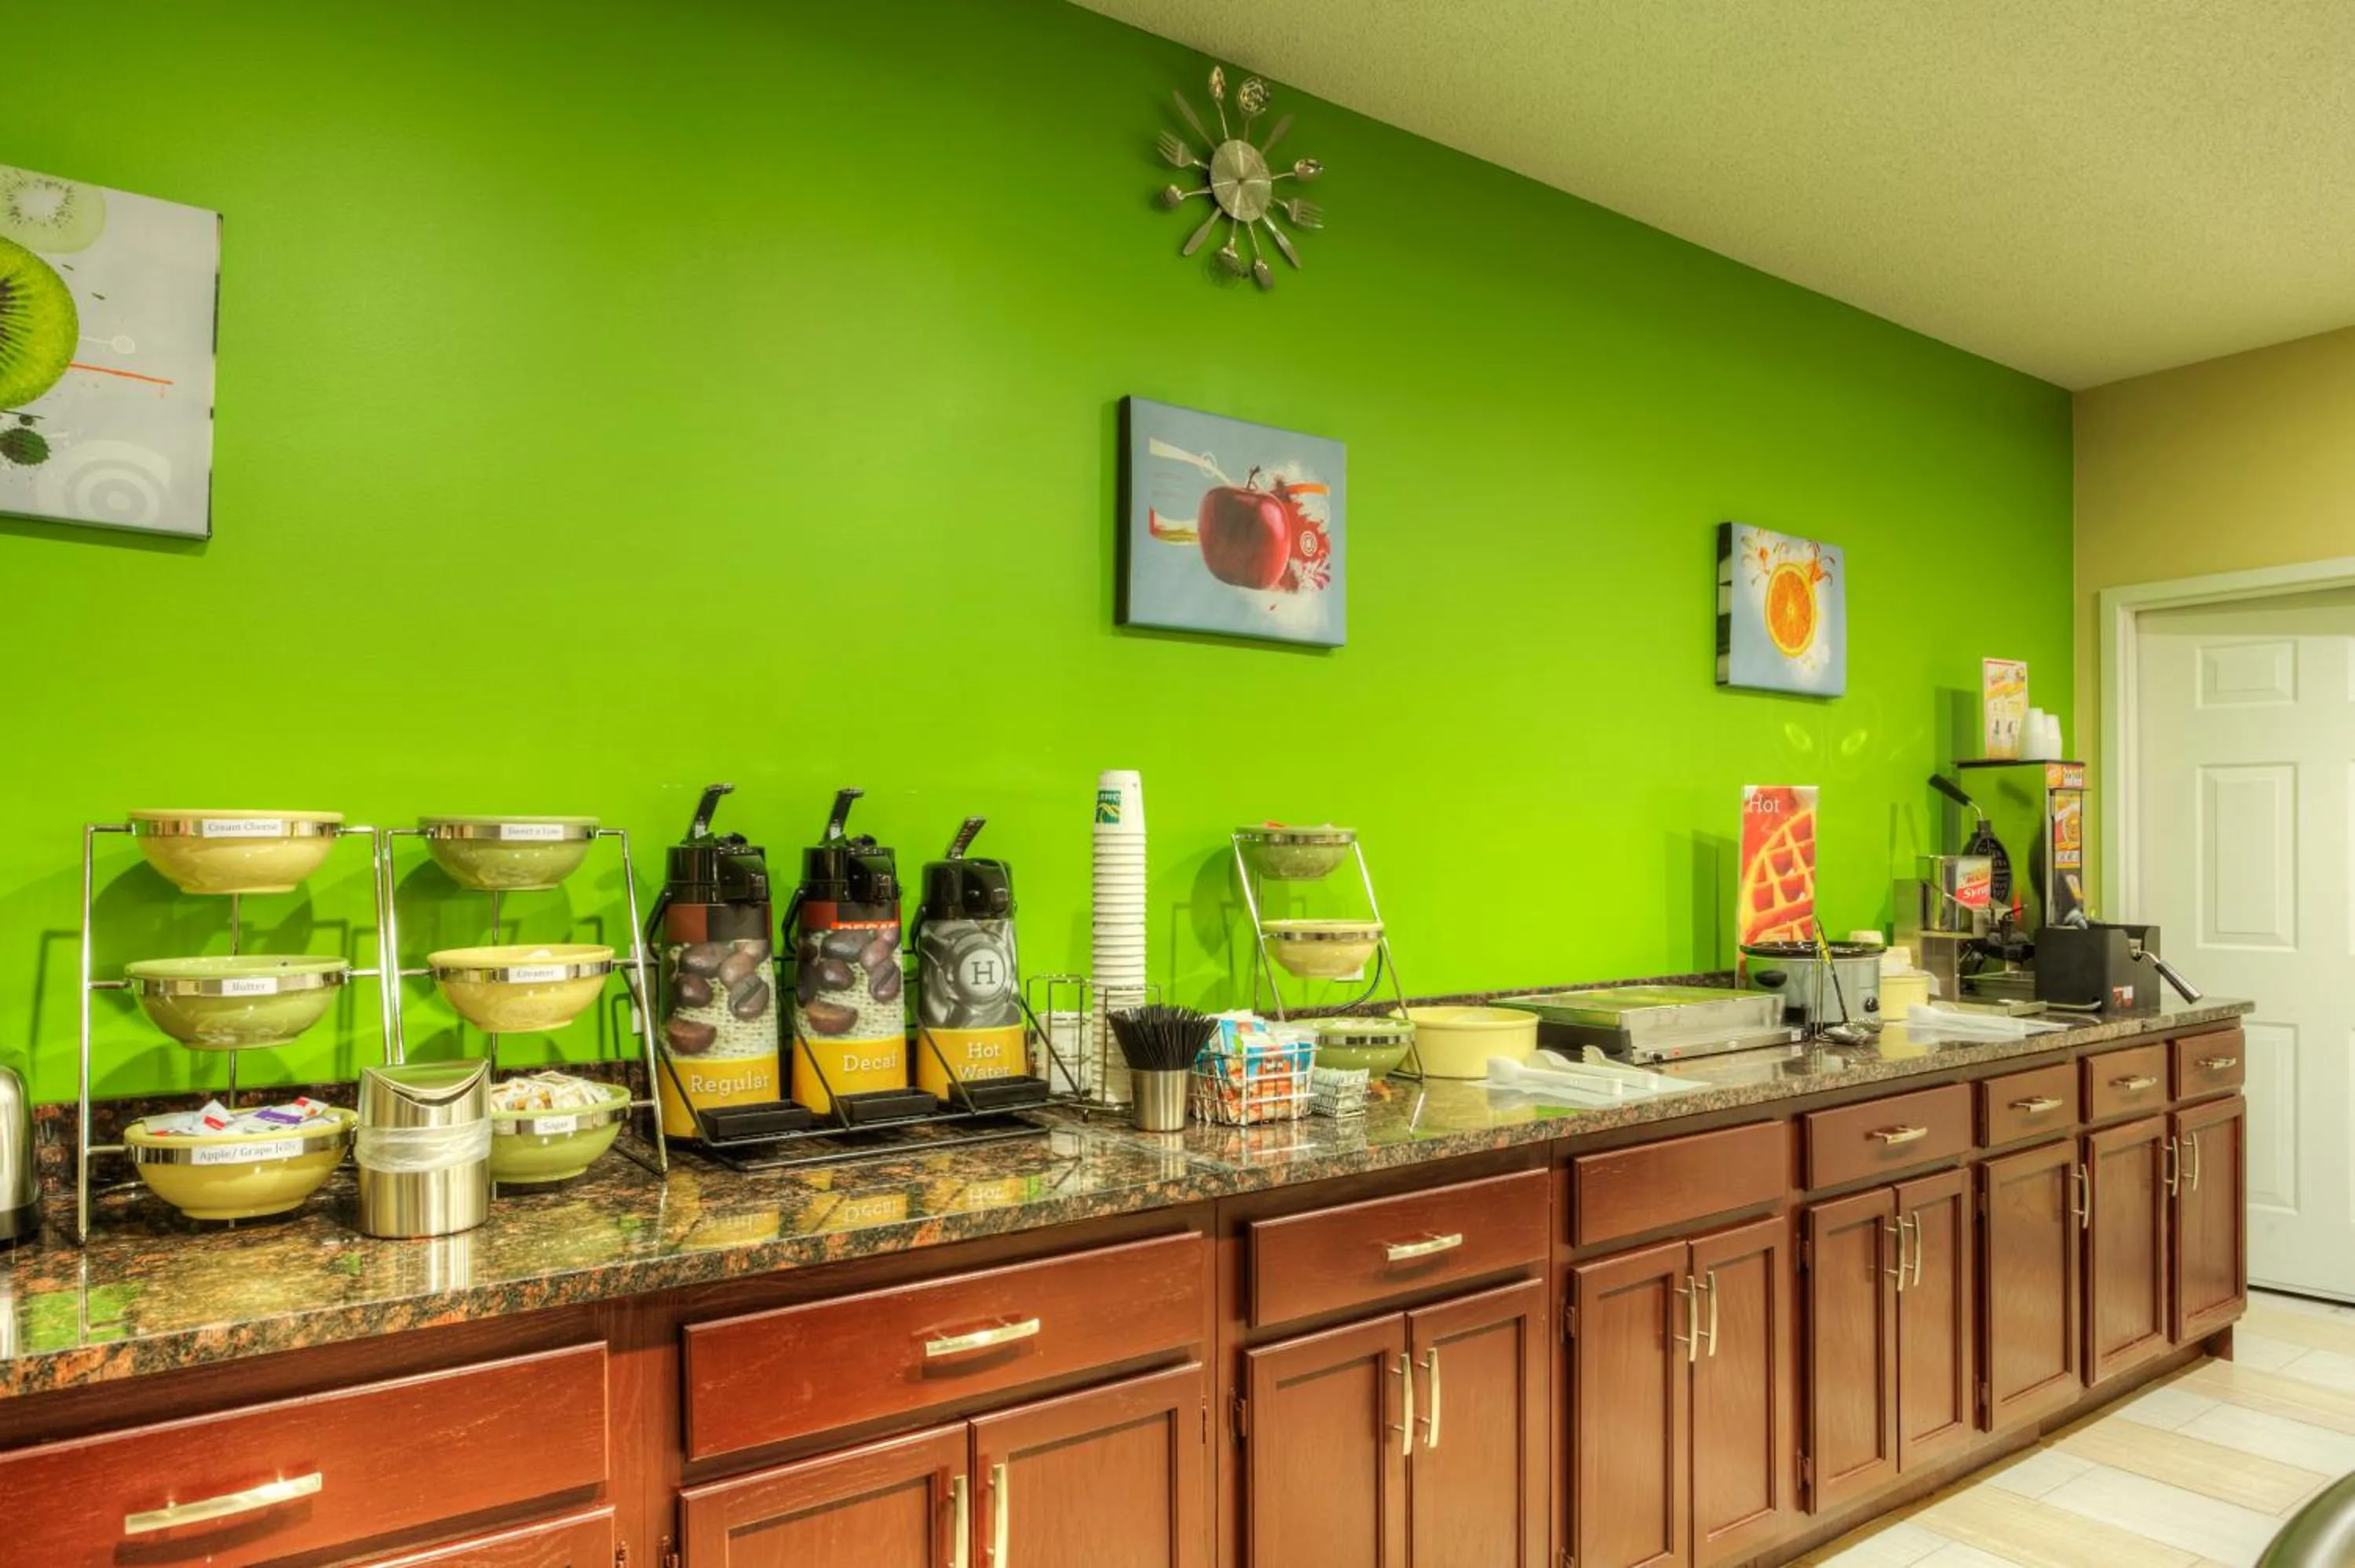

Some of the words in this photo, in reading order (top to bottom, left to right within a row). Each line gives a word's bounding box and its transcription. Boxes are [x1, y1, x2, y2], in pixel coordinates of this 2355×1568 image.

[1747, 793, 1780, 813] Hot
[207, 822, 241, 832] Cream
[971, 960, 996, 985] H
[842, 1047, 899, 1072] Decaf
[966, 1041, 1001, 1059] Hot
[957, 1063, 1011, 1081] Water
[691, 1070, 770, 1096] Regular
